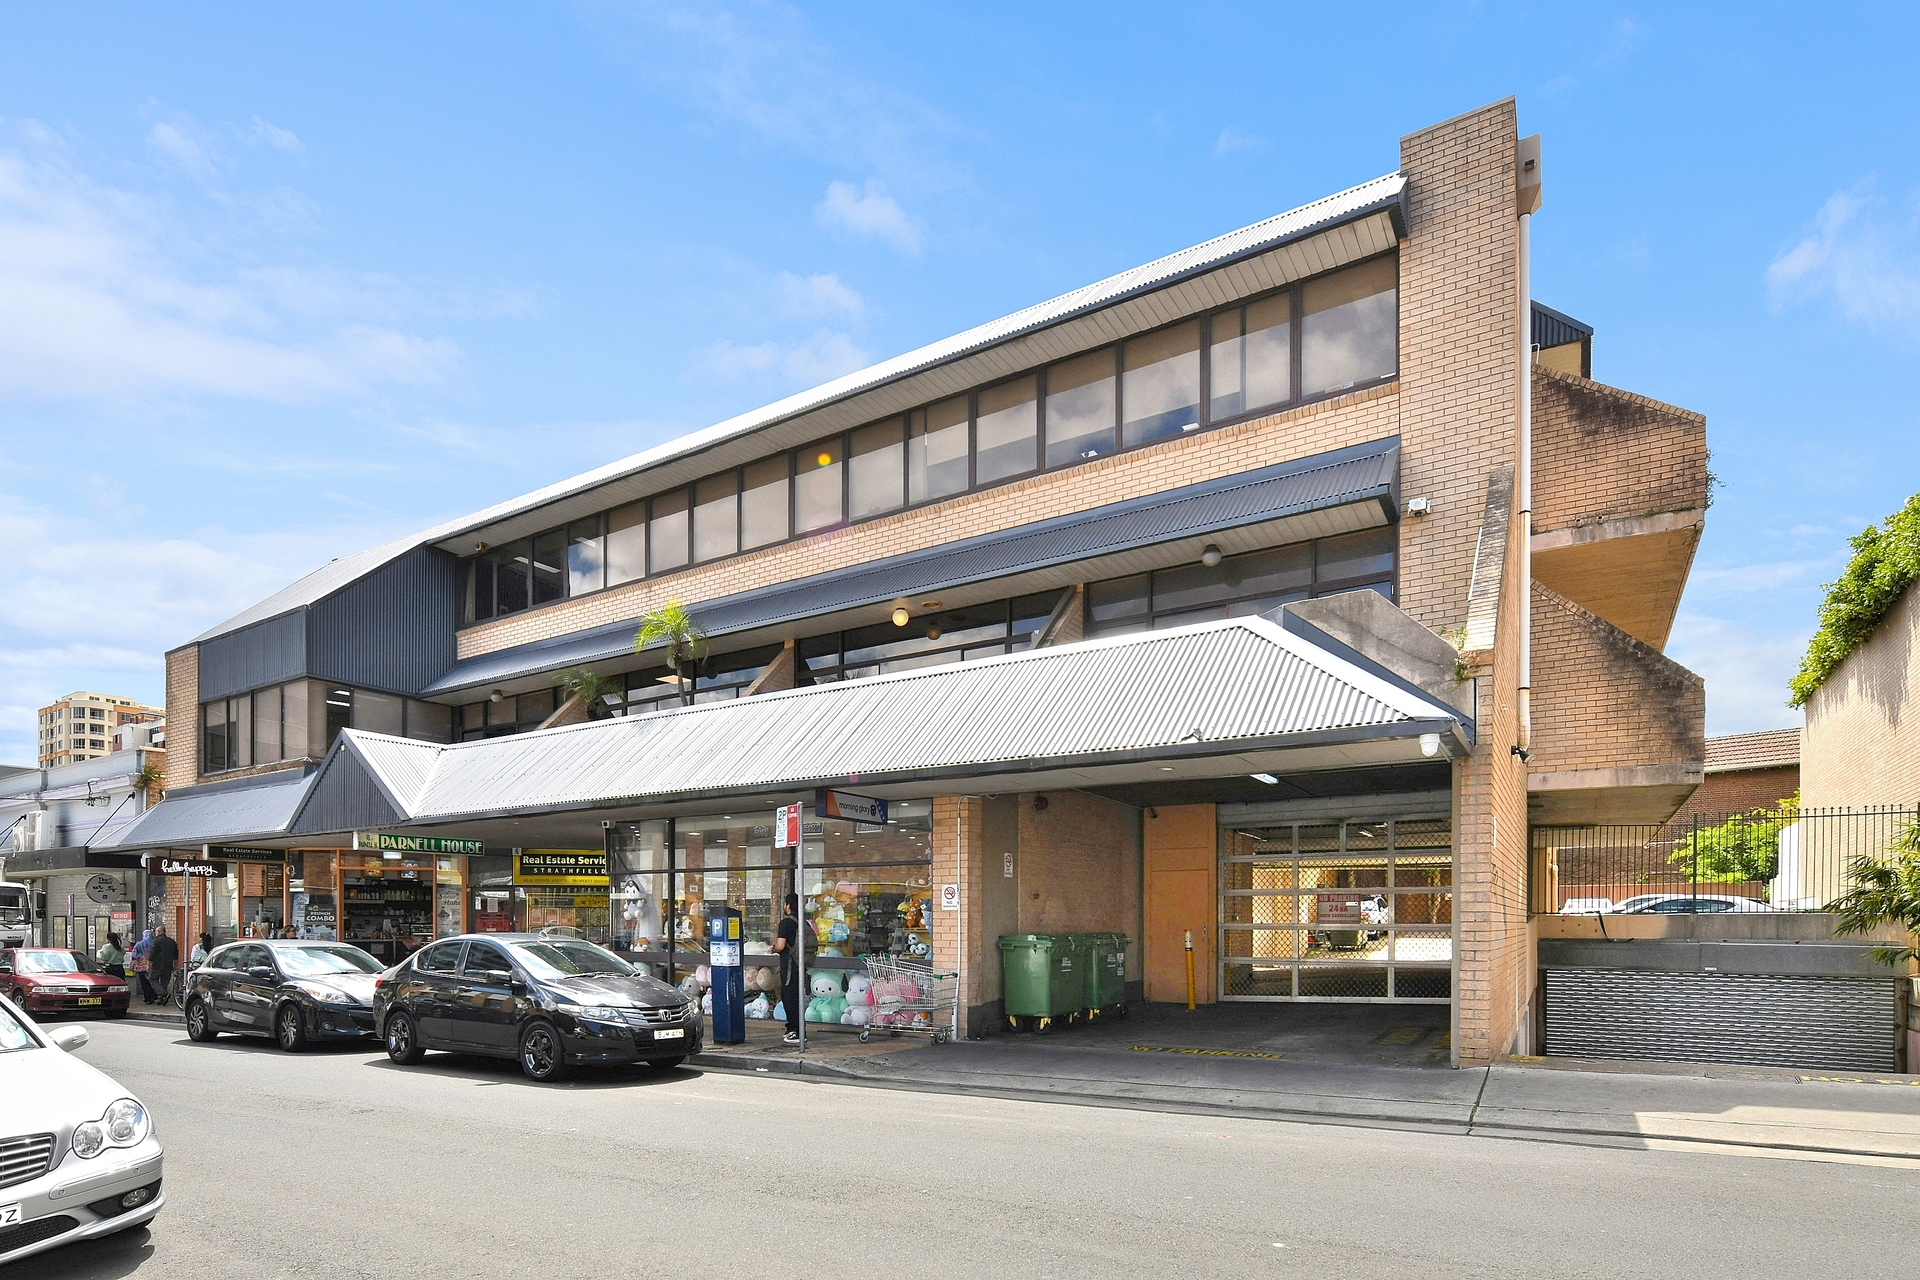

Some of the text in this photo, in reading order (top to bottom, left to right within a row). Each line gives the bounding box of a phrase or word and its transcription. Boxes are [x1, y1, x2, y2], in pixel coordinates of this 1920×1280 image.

[778, 810, 787, 820] 2P
[839, 802, 870, 815] morning glory
[380, 835, 438, 851] PARNELL
[441, 840, 482, 854] HOUSE
[523, 855, 544, 864] Real
[546, 856, 575, 864] Estate
[1319, 894, 1329, 902] NO
[714, 921, 721, 935] P
[0, 1209, 18, 1223] Z
